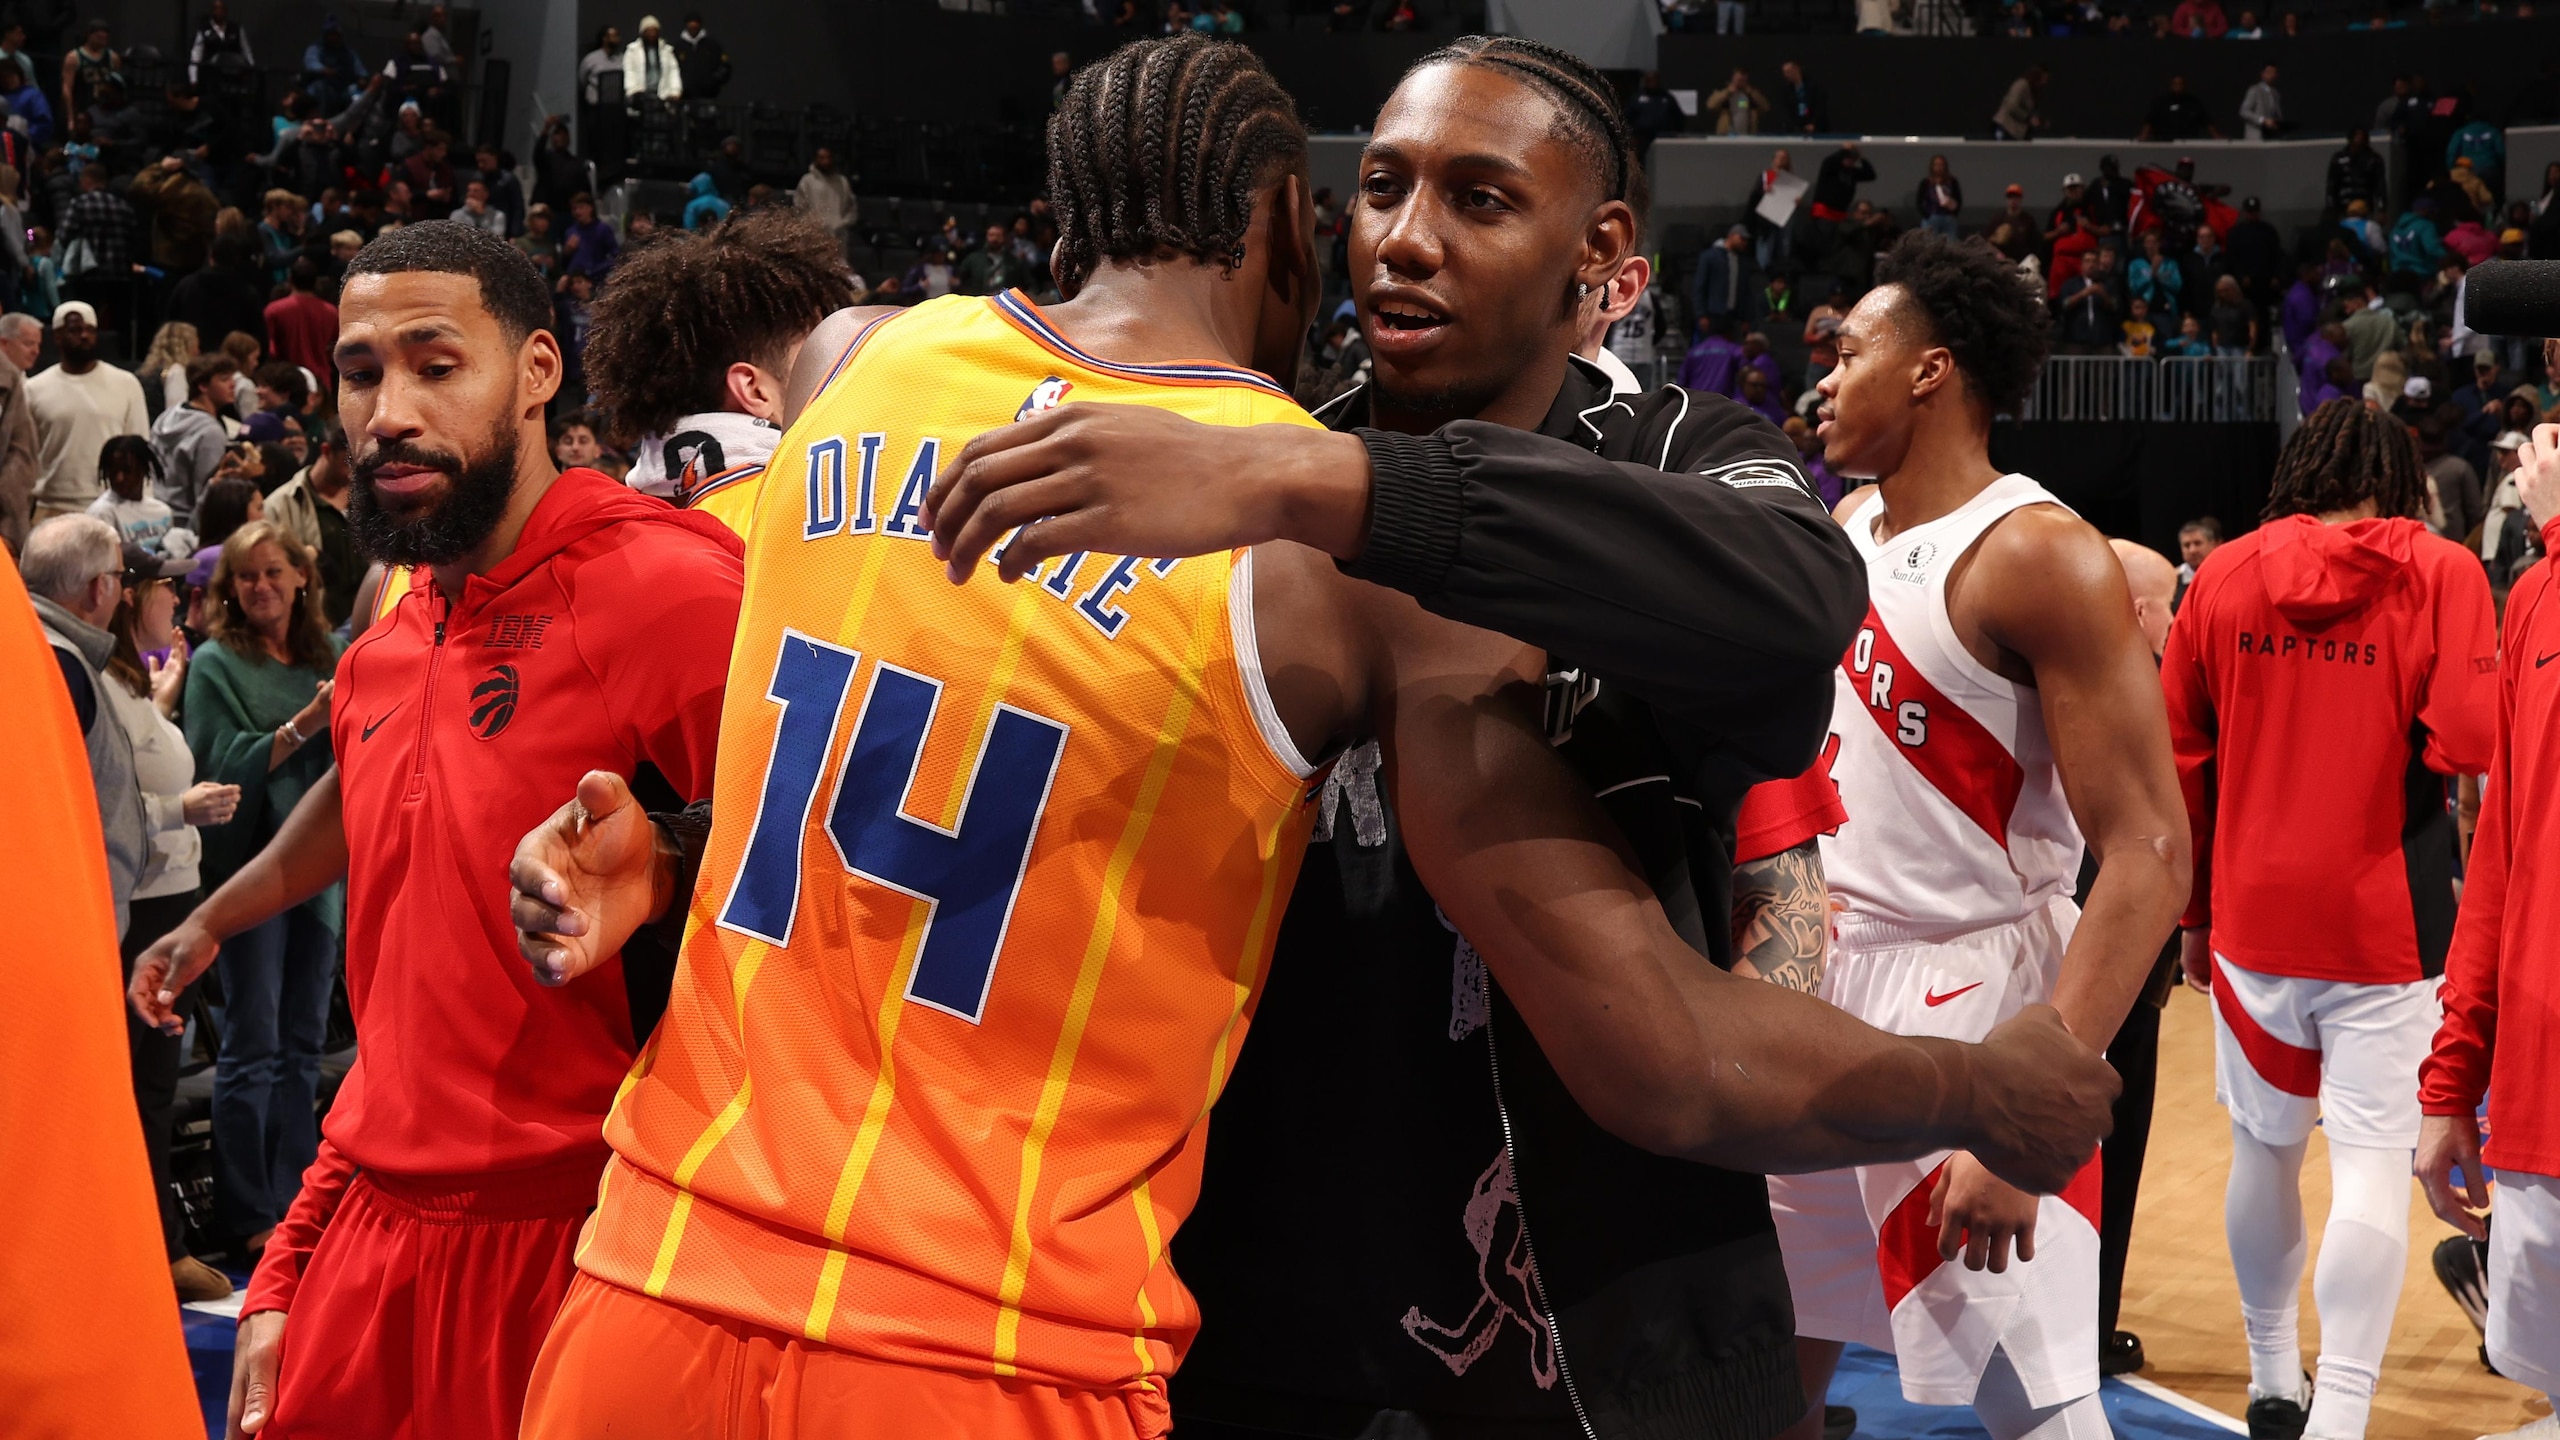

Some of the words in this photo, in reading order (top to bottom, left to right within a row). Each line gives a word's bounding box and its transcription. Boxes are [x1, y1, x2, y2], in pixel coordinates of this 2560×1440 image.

[1890, 568, 1908, 581] Sun
[1908, 572, 1926, 585] Life
[483, 614, 553, 650] IBM
[2238, 631, 2377, 666] RAPTORS
[716, 627, 1070, 1025] 14
[1776, 888, 1821, 917] Love
